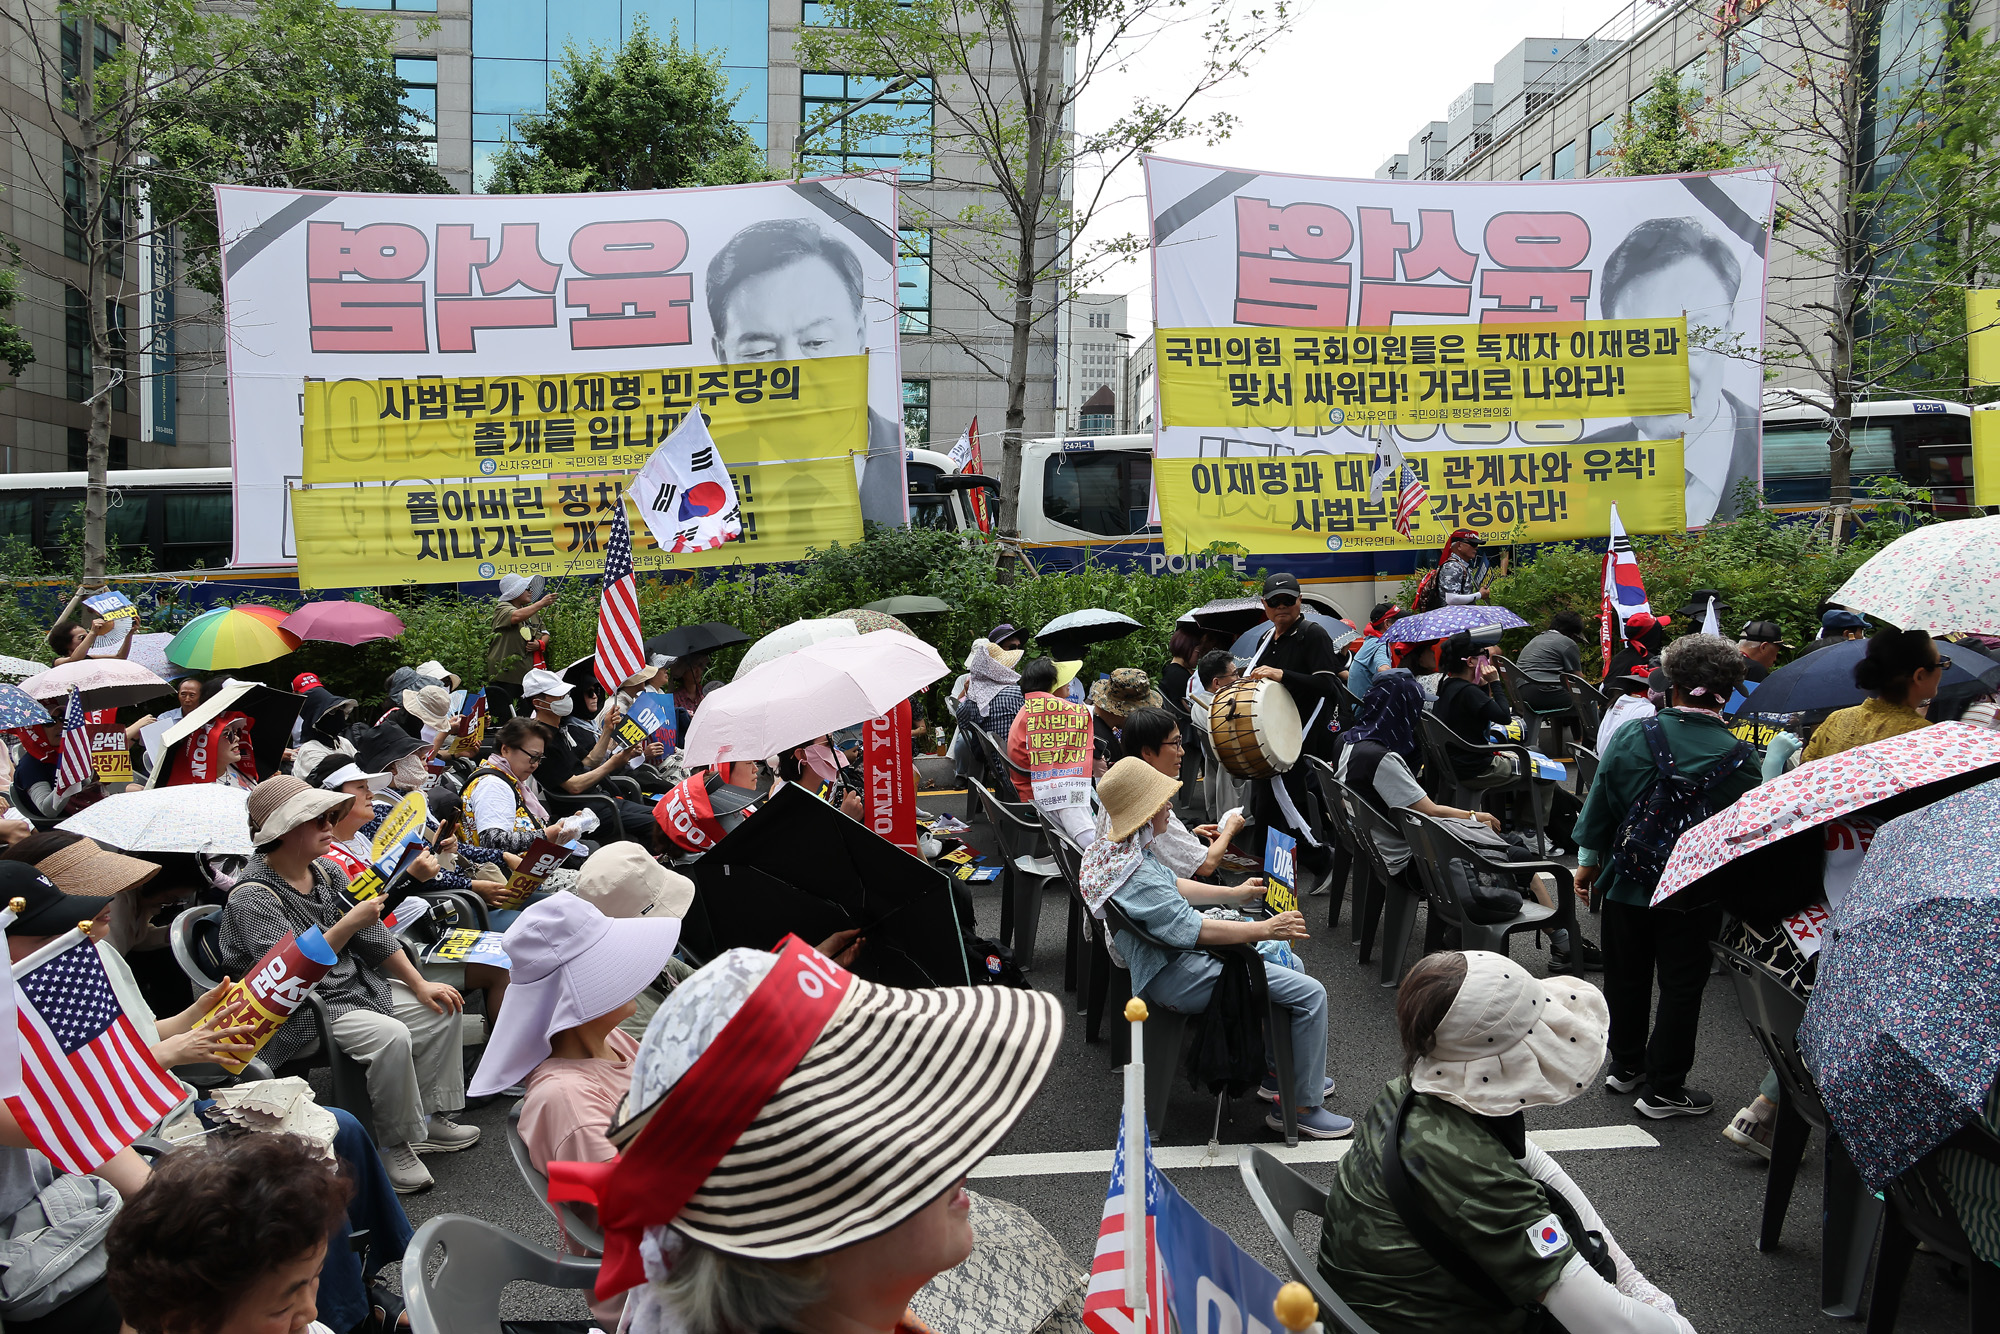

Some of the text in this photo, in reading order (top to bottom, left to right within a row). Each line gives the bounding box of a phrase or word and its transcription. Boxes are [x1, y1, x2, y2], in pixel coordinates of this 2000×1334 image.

[1165, 326, 1681, 368] 국민의힘 국회의원들은 독재자 이재명과
[379, 380, 525, 422] 사법부가
[1228, 365, 1626, 408] 맞서 싸워라! 거리로 나와라!
[1346, 406, 1513, 423] 신자유연대 국민의힘 평당원협의회
[1917, 403, 1943, 412] 24기-1
[473, 416, 577, 456] 졸개들
[1064, 441, 1091, 450] 24기-1
[499, 457, 553, 471] 신자유연대
[565, 455, 608, 468] 국민의힘
[1191, 459, 1324, 497] 이재명과
[1443, 451, 1573, 491] 관계자와
[1583, 446, 1656, 482] 유착!
[406, 487, 546, 525] 쫄아버린
[1431, 489, 1569, 529] 각성하라!
[414, 525, 555, 563] 지나가는
[1343, 535, 1396, 548] 신자유연대
[497, 561, 552, 575] 신자유연대
[1027, 714, 1089, 732] 결사반대!
[91, 731, 127, 752] 윤석열
[872, 757, 894, 836] ONLY,
[896, 779, 904, 804] MAKE
